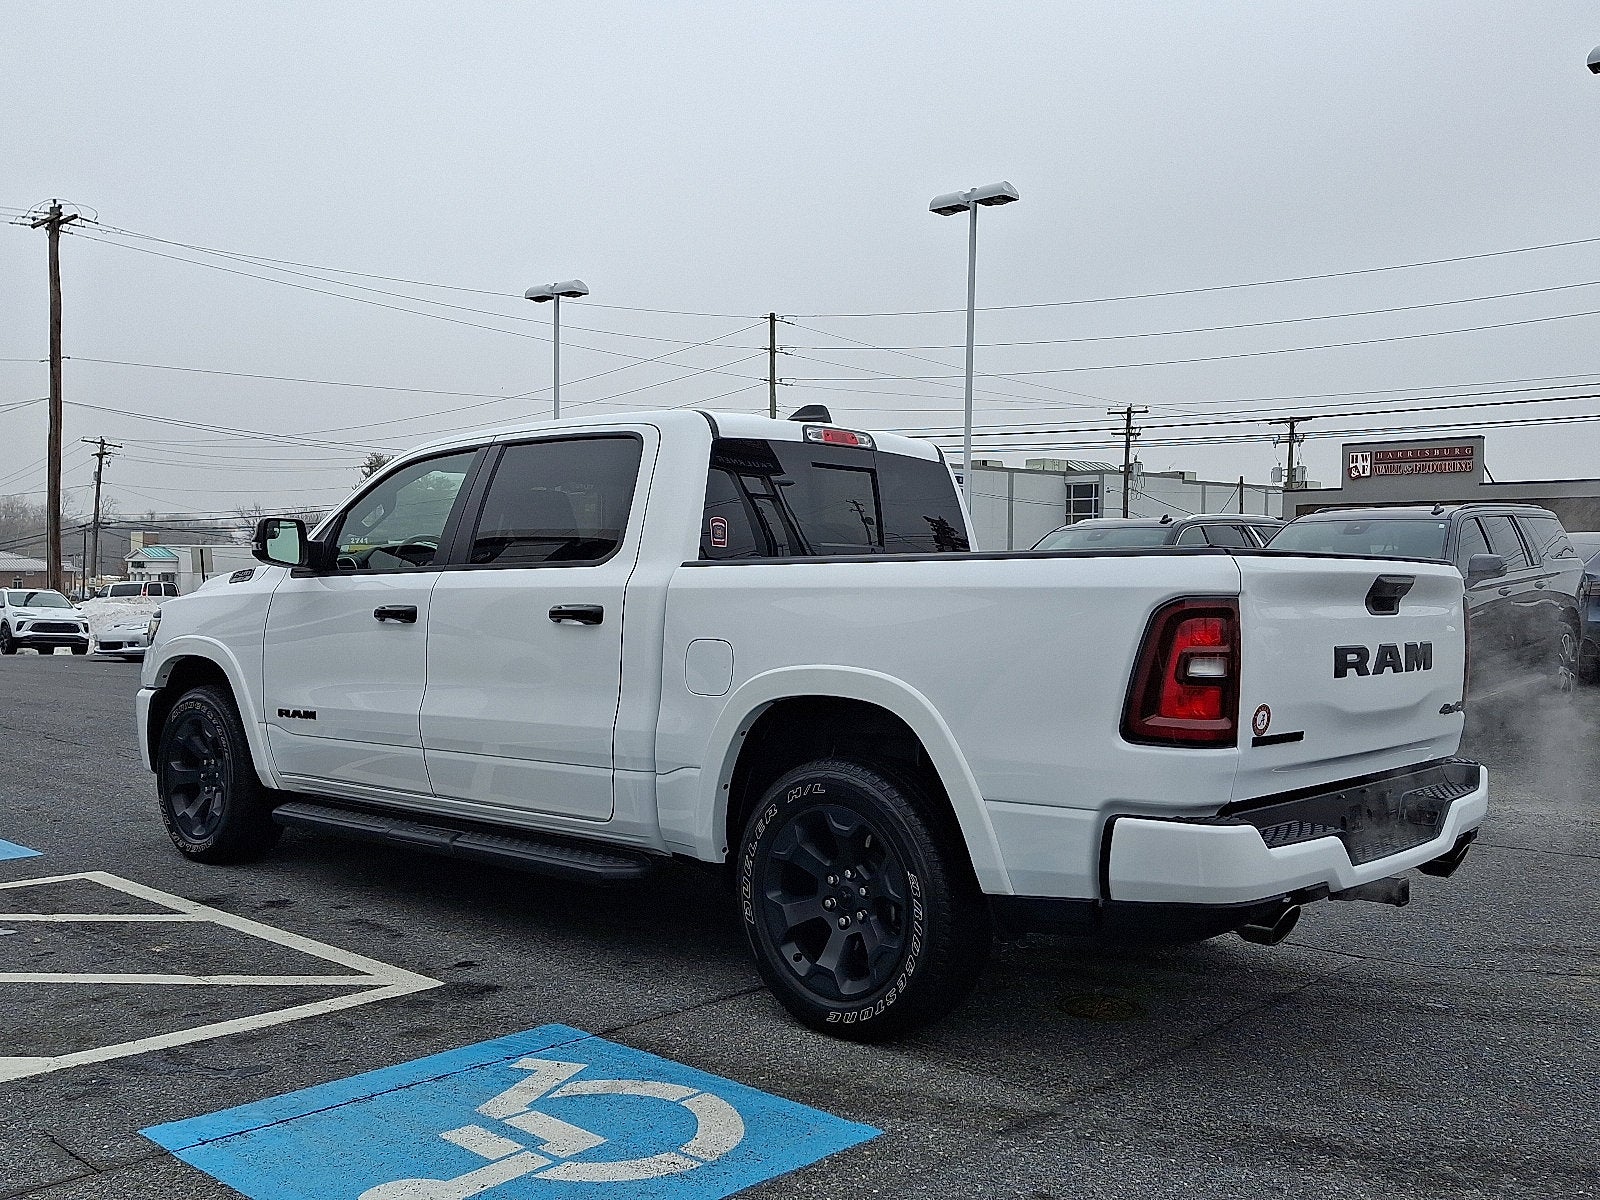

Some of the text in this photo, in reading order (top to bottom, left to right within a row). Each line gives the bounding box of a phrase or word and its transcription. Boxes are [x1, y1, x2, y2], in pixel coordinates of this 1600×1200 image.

[1377, 447, 1472, 459] HARRISBURG
[1373, 460, 1474, 476] WALL & FLOORING
[1333, 641, 1433, 679] RAM
[277, 708, 317, 720] RAM
[787, 783, 826, 803] H/L
[742, 803, 778, 924] DUELER
[826, 870, 923, 1024] BRIDGESTONE
